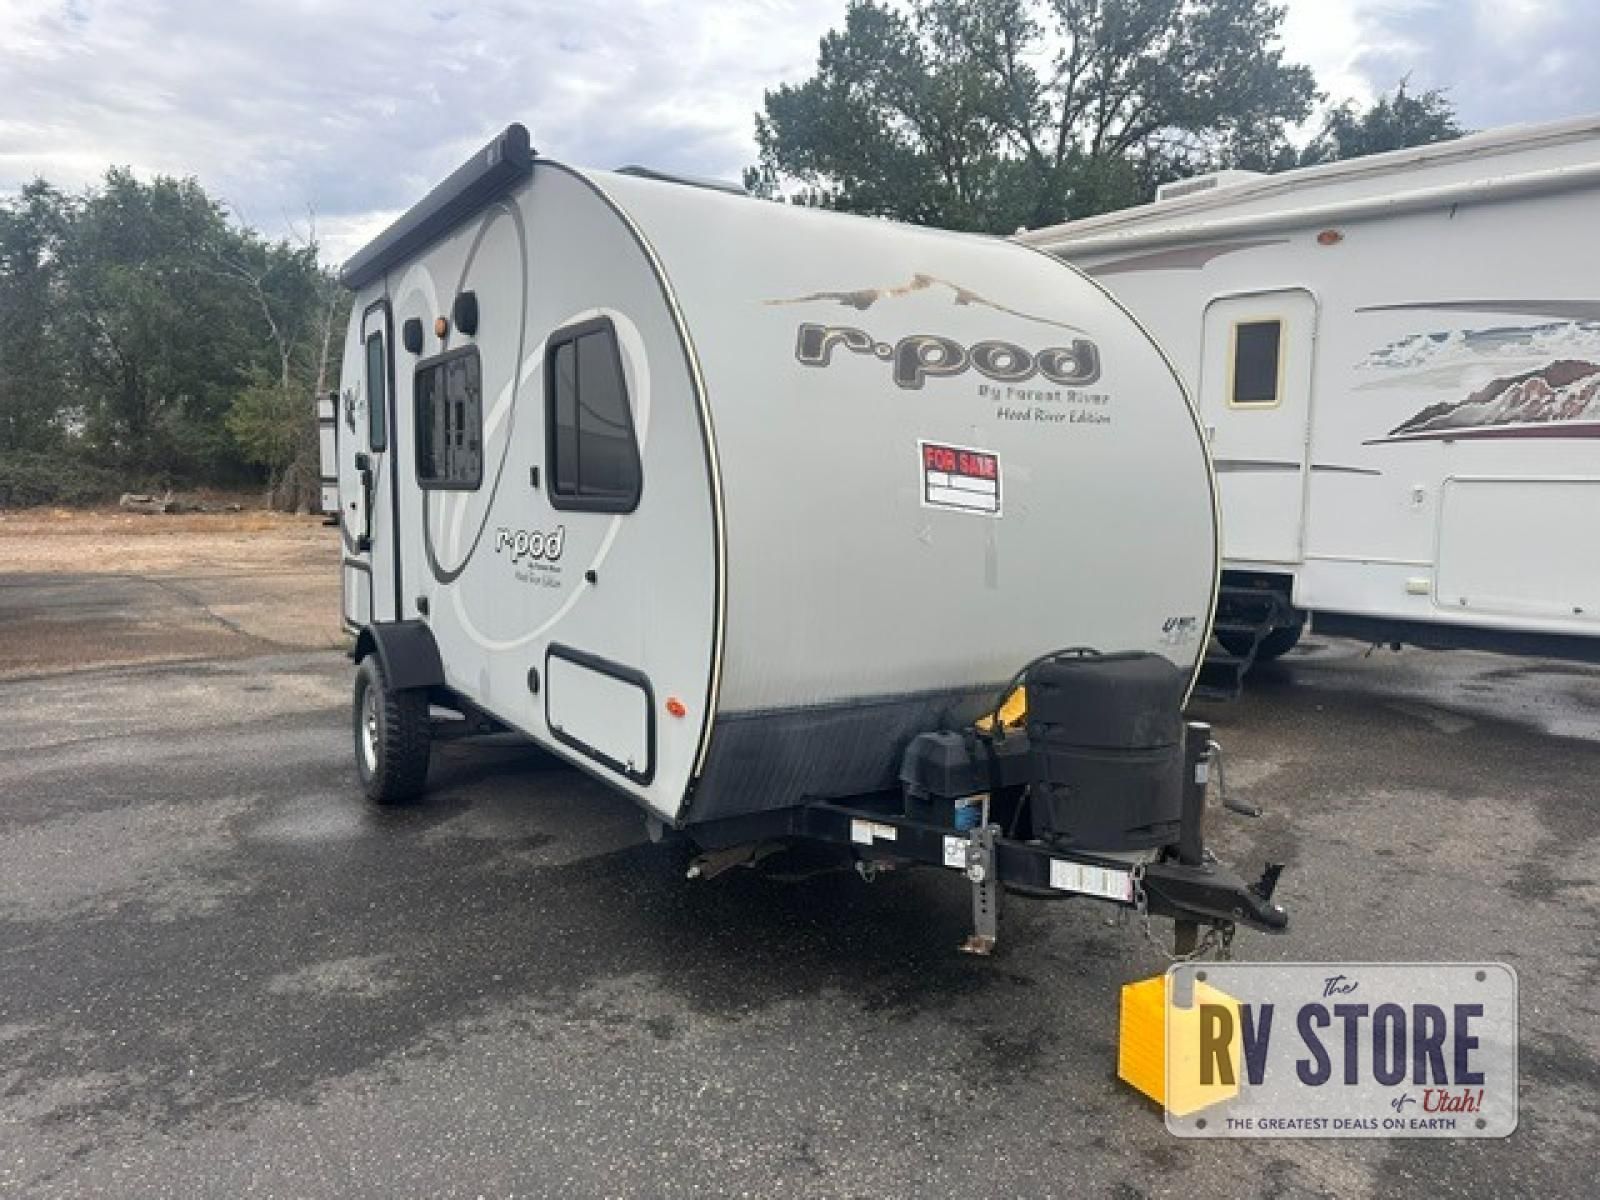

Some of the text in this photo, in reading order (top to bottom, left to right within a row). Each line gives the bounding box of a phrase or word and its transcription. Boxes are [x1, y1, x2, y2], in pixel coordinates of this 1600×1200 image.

[979, 385, 1110, 405] By Forest River
[1034, 408, 1066, 423] River
[1069, 410, 1111, 424] Edition
[925, 446, 995, 478] FOR SALE
